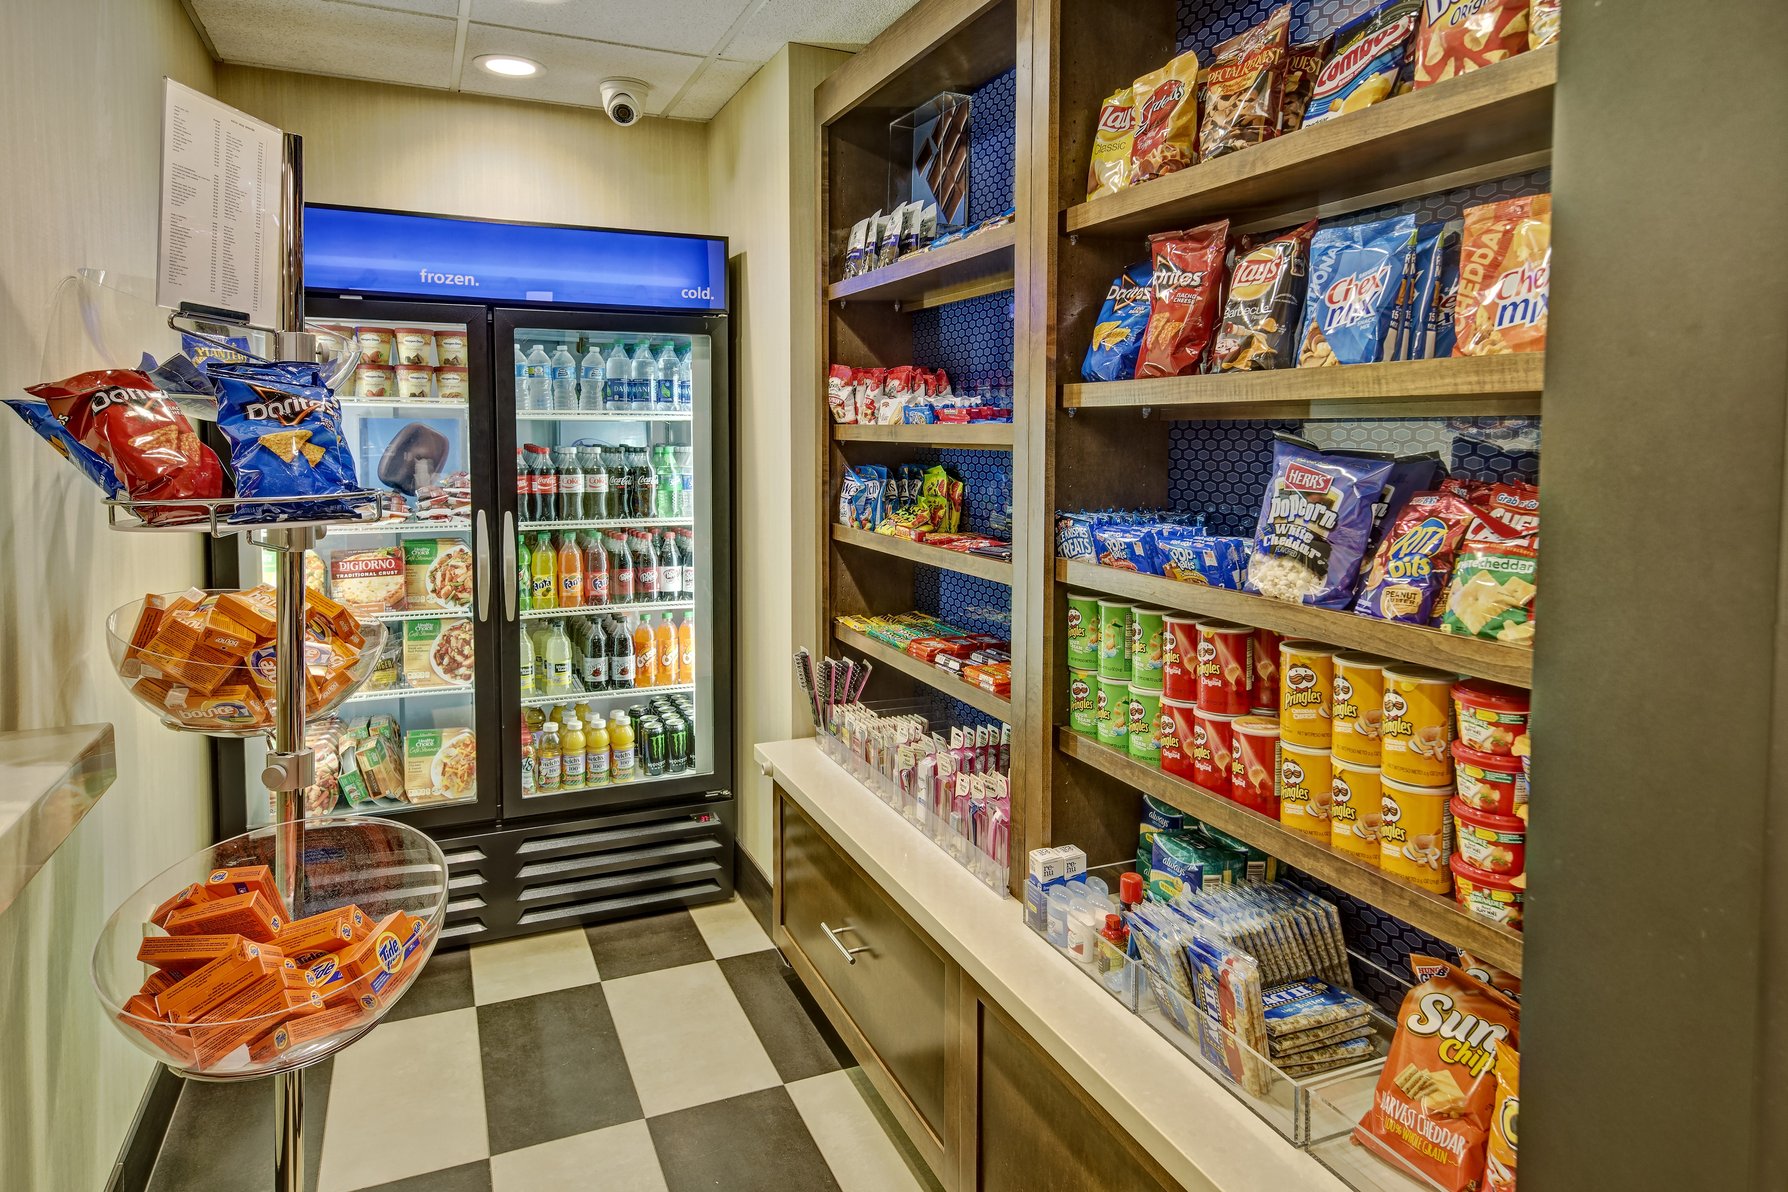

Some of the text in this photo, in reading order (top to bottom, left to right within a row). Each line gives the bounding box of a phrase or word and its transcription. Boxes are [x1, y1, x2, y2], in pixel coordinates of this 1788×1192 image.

[1318, 24, 1400, 88] Combos
[419, 269, 480, 287] frozen.
[1232, 257, 1283, 287] Lay's
[681, 286, 715, 300] cold.
[1106, 284, 1152, 301] Doritos
[1326, 264, 1392, 305] Chex
[1288, 468, 1327, 490] HERR'S
[1268, 493, 1339, 530] popcorn
[1496, 493, 1519, 505] Grab
[1526, 500, 1538, 509] Go
[1275, 523, 1315, 543] White
[1388, 525, 1448, 560] RITZ
[1263, 534, 1322, 559] Cheddar
[336, 571, 377, 579] TRADITIONAL
[1386, 590, 1418, 600] PEANUT
[1284, 688, 1322, 710] Pringles
[179, 705, 236, 719] bounce
[1148, 811, 1170, 828] always
[1162, 857, 1185, 876] always
[379, 937, 400, 962] Tide
[311, 961, 336, 980] Tide
[1262, 988, 1291, 1007] ACT
[1406, 992, 1509, 1052] Sun
[1380, 1089, 1416, 1128] HARVEST
[1416, 1111, 1467, 1157] CHEDDAR
[1384, 1116, 1449, 1165] 100% WHOLE GRAIN
